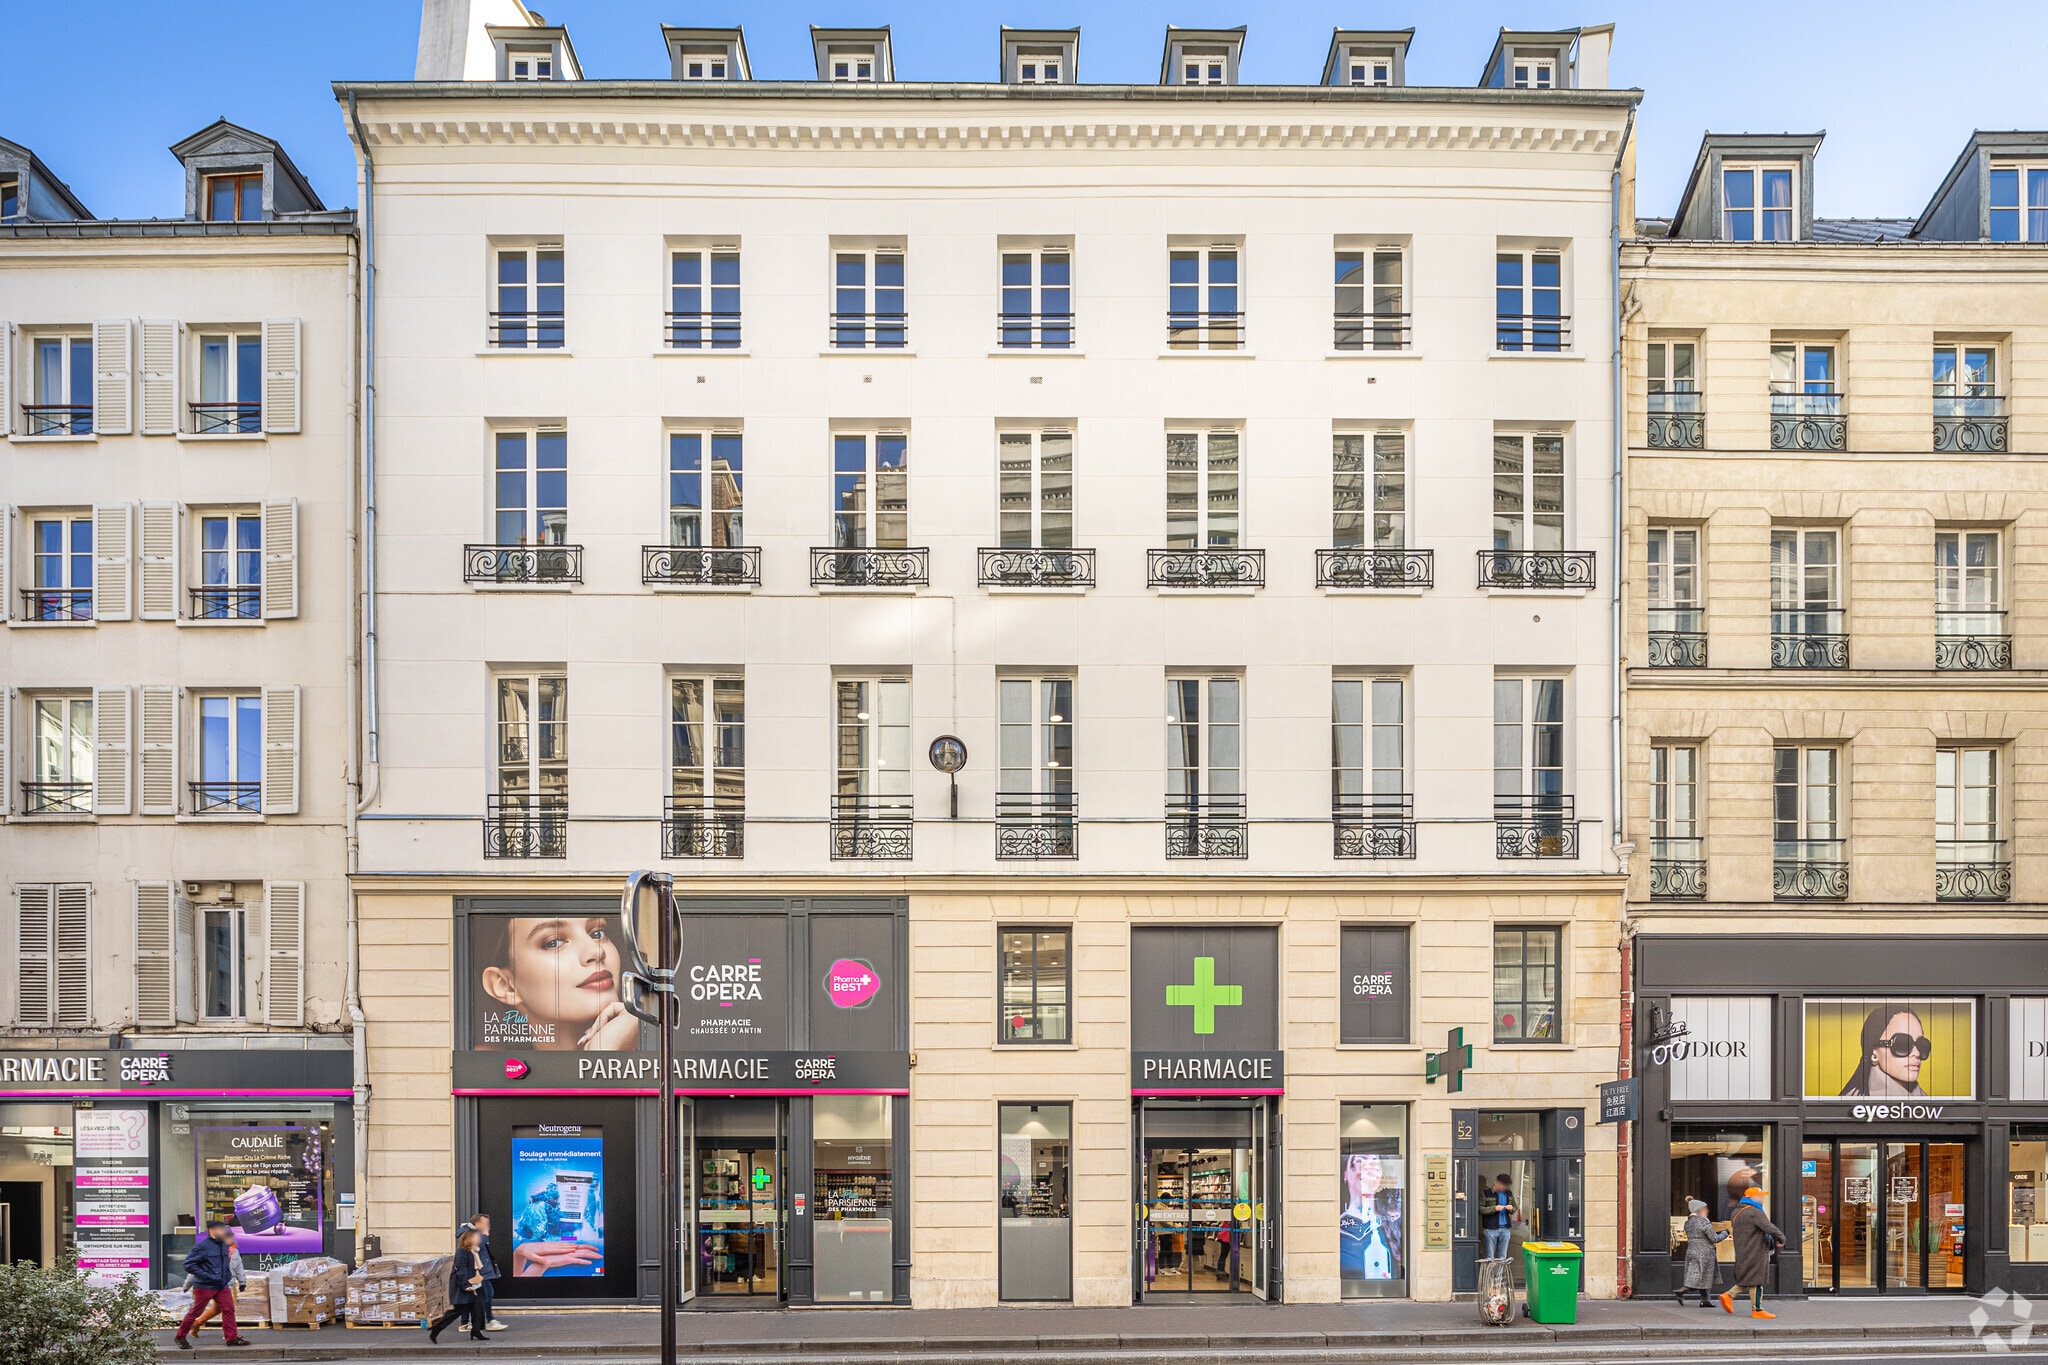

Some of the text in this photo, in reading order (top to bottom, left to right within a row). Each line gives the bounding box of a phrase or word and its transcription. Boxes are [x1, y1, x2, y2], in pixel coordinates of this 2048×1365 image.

[484, 1010, 529, 1025] LA Plus
[700, 1019, 751, 1027] PHARMACIE
[484, 1024, 555, 1035] PARISIENNE
[690, 1026, 728, 1035] CHAUSSÉE
[1692, 1041, 1748, 1057] DIOR
[0, 1057, 104, 1081] RMACIE
[1143, 1058, 1273, 1079] PHARMACIE
[1602, 1085, 1630, 1096] DUTY FREE
[1852, 1101, 1944, 1122] eyeshow
[538, 1124, 582, 1133] Neutrogena
[1457, 1126, 1473, 1138] 52
[828, 1199, 877, 1207] PARISIENNE
[259, 1254, 273, 1262] LA
